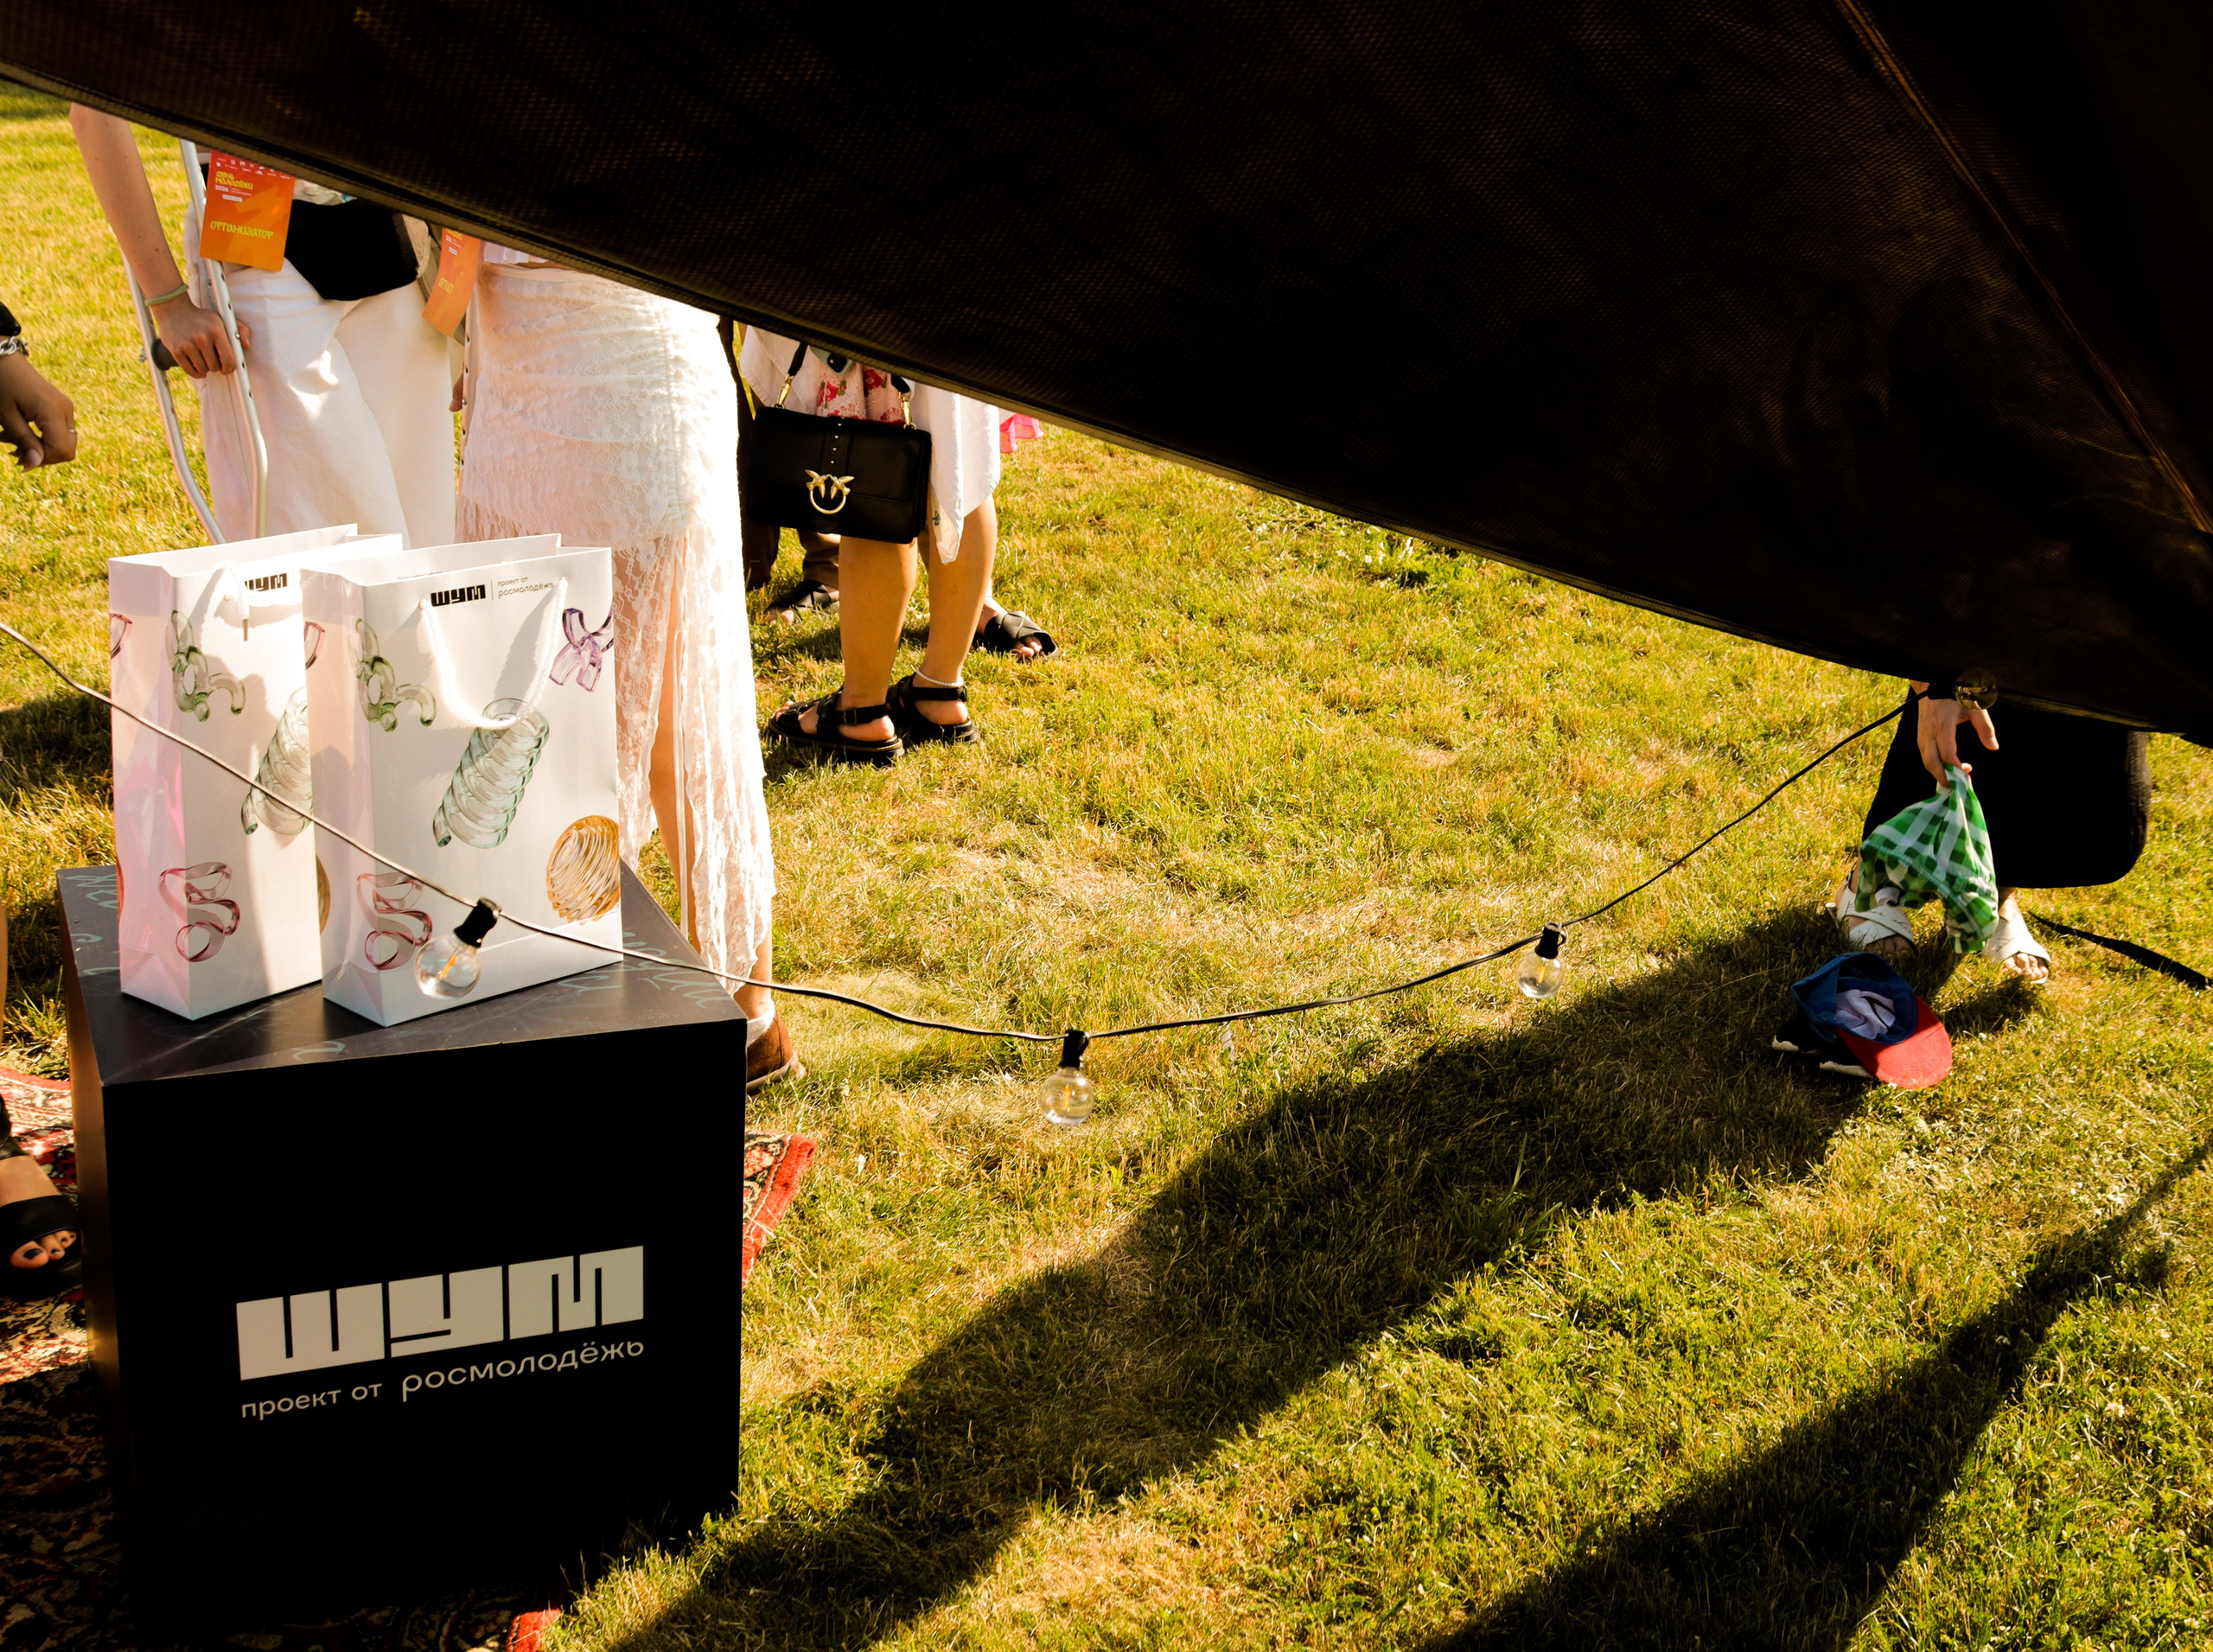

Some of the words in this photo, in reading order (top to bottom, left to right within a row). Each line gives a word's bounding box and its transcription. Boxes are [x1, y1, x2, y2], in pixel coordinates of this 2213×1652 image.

[498, 578, 520, 588] проект
[498, 582, 555, 597] росмолодёжь
[241, 1388, 341, 1420] проект
[352, 1382, 383, 1401] от
[402, 1341, 645, 1402] росмолодёжь
